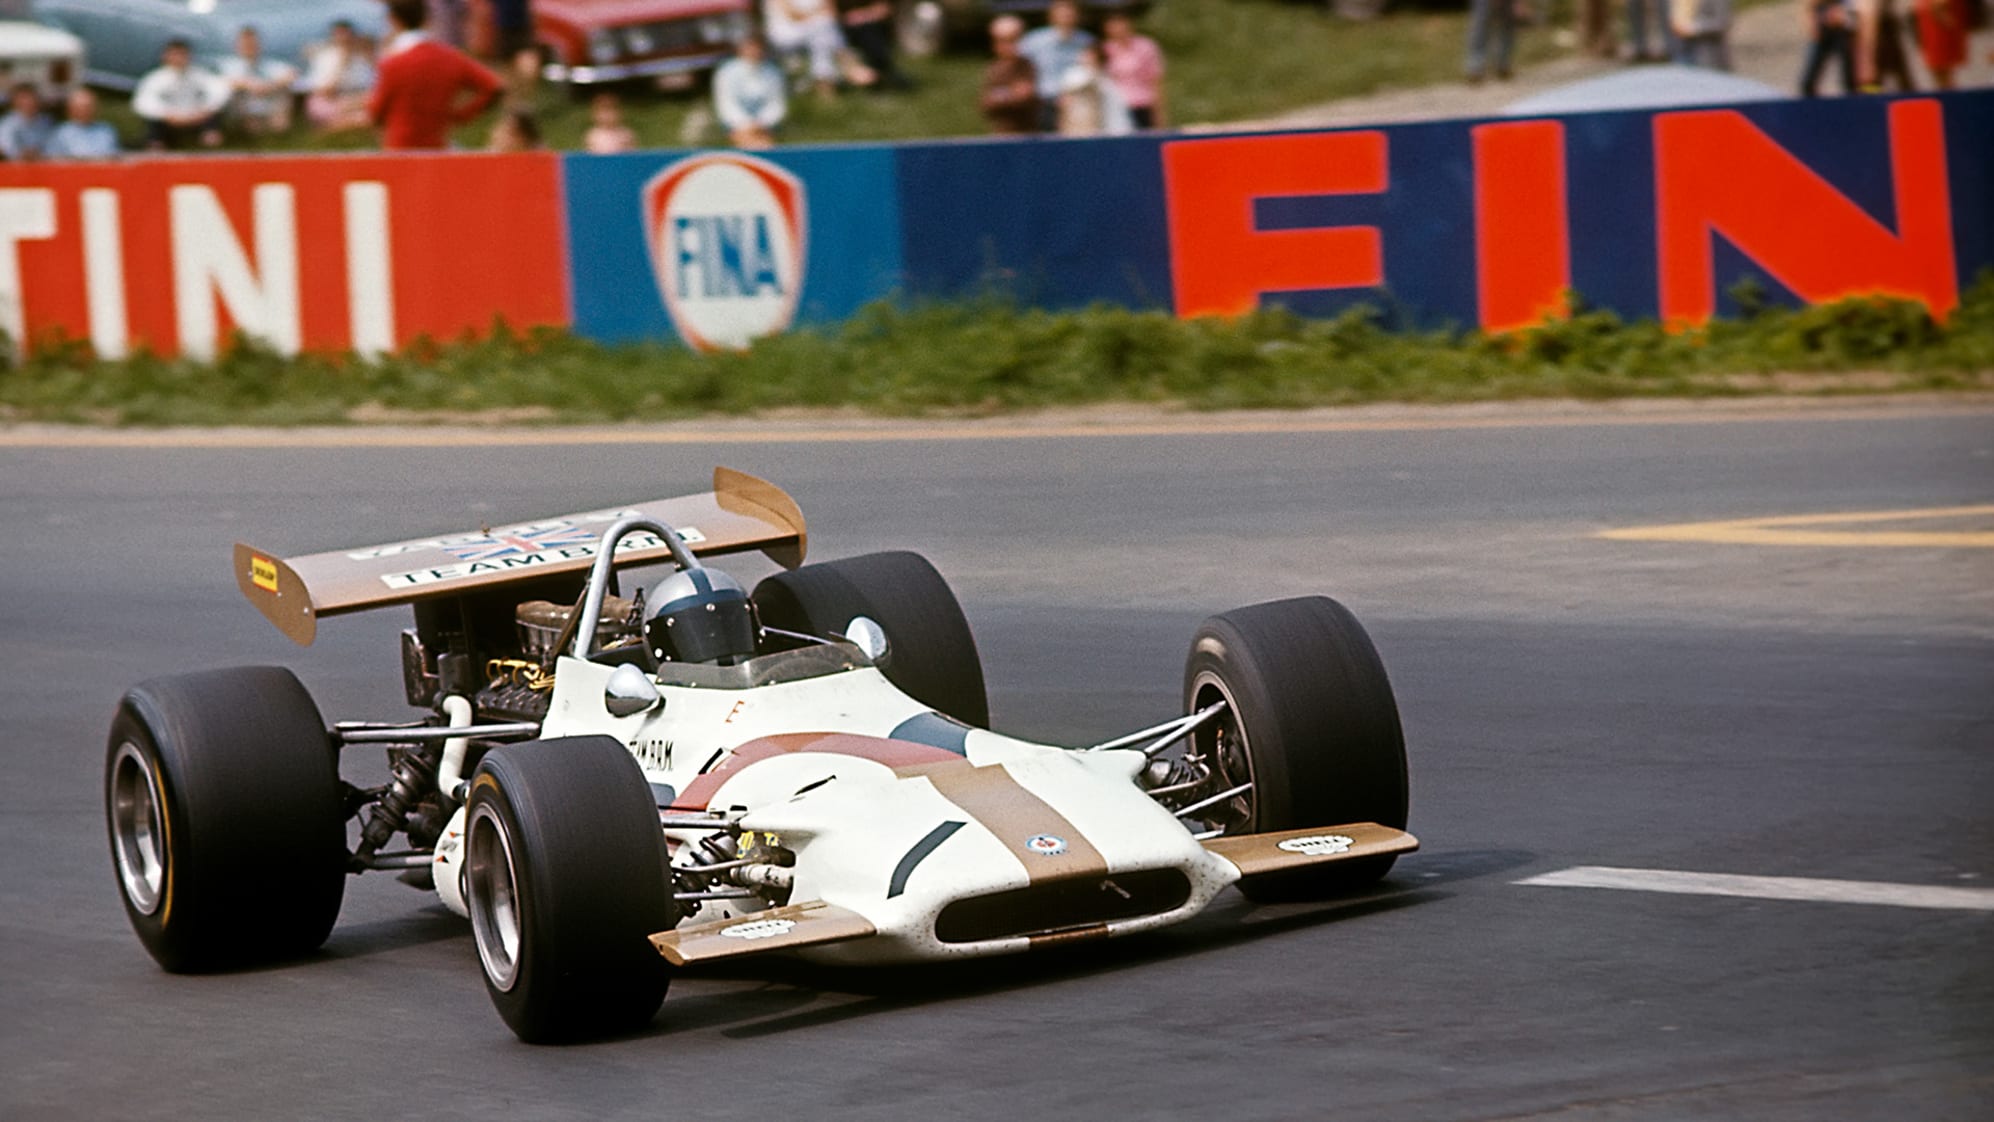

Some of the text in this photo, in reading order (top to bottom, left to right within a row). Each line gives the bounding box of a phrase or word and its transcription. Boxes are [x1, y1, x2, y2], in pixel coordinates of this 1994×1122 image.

[676, 216, 784, 298] FINA
[1163, 99, 1957, 335] FIN
[391, 552, 546, 584] TEAM
